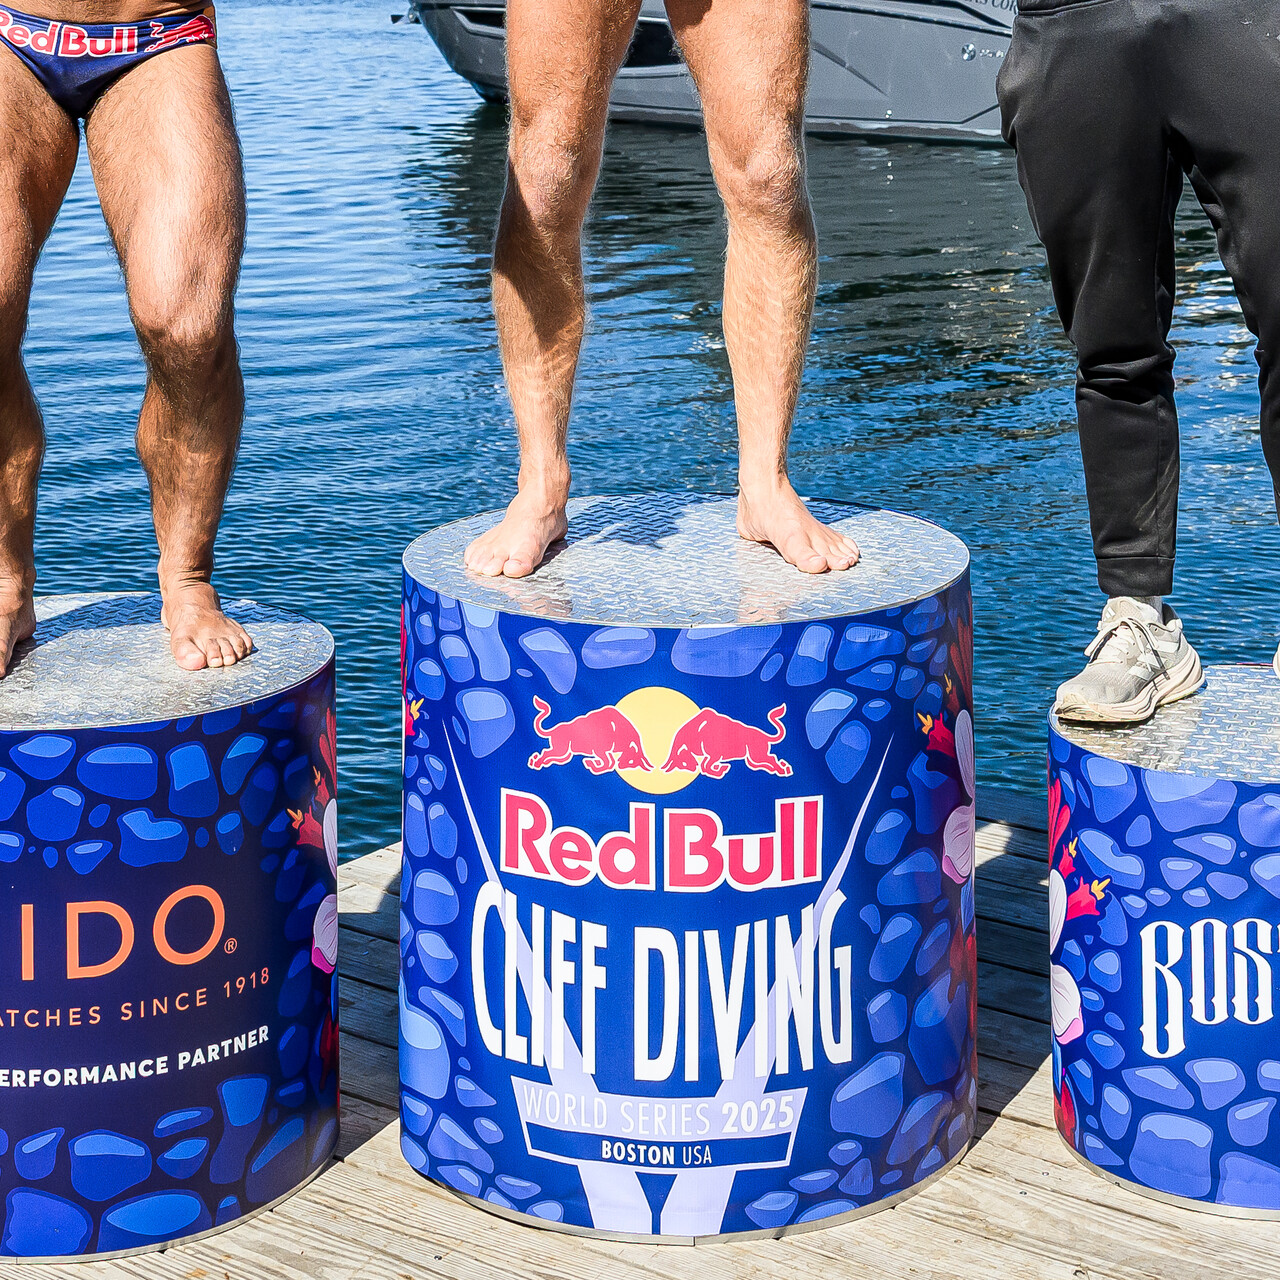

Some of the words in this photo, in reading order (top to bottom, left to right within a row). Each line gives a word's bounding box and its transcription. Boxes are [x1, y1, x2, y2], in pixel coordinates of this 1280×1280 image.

[59, 25, 138, 57] Bull
[500, 787, 656, 891] Red
[663, 794, 823, 892] Bull
[120, 987, 208, 1021] SINCE
[223, 967, 270, 999] 1918
[470, 880, 608, 1075] CLIFF
[634, 889, 853, 1082] DIVING
[177, 1024, 271, 1071] PARTNER
[523, 1083, 606, 1129] WORLD
[620, 1095, 710, 1136] SERIES
[721, 1094, 794, 1134] 2025
[601, 1139, 675, 1166] BOSTON
[681, 1144, 713, 1166] USA
